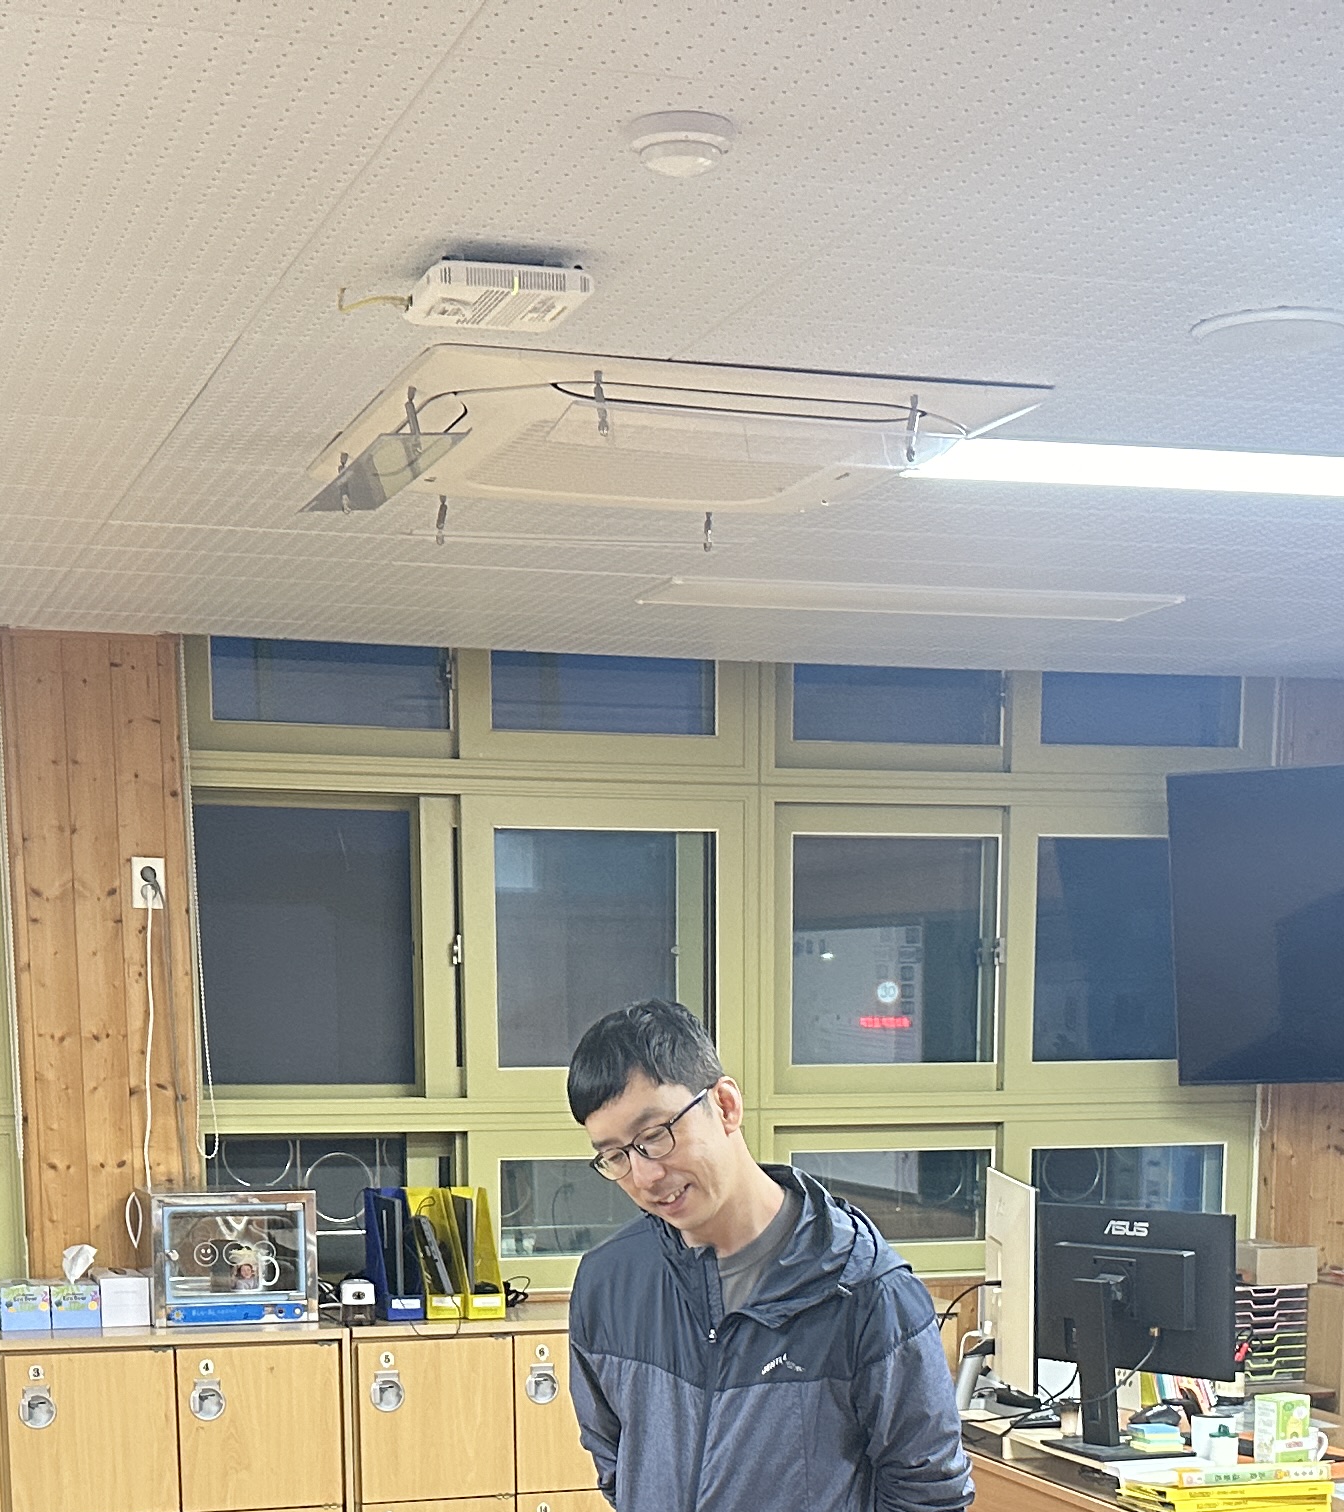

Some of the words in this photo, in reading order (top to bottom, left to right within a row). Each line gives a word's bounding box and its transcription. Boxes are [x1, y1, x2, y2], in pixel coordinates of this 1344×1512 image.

[1104, 1220, 1149, 1237] ASUS
[538, 1347, 546, 1357] 6
[384, 1354, 391, 1364] 5
[202, 1362, 210, 1371] 4
[32, 1367, 41, 1378] 3
